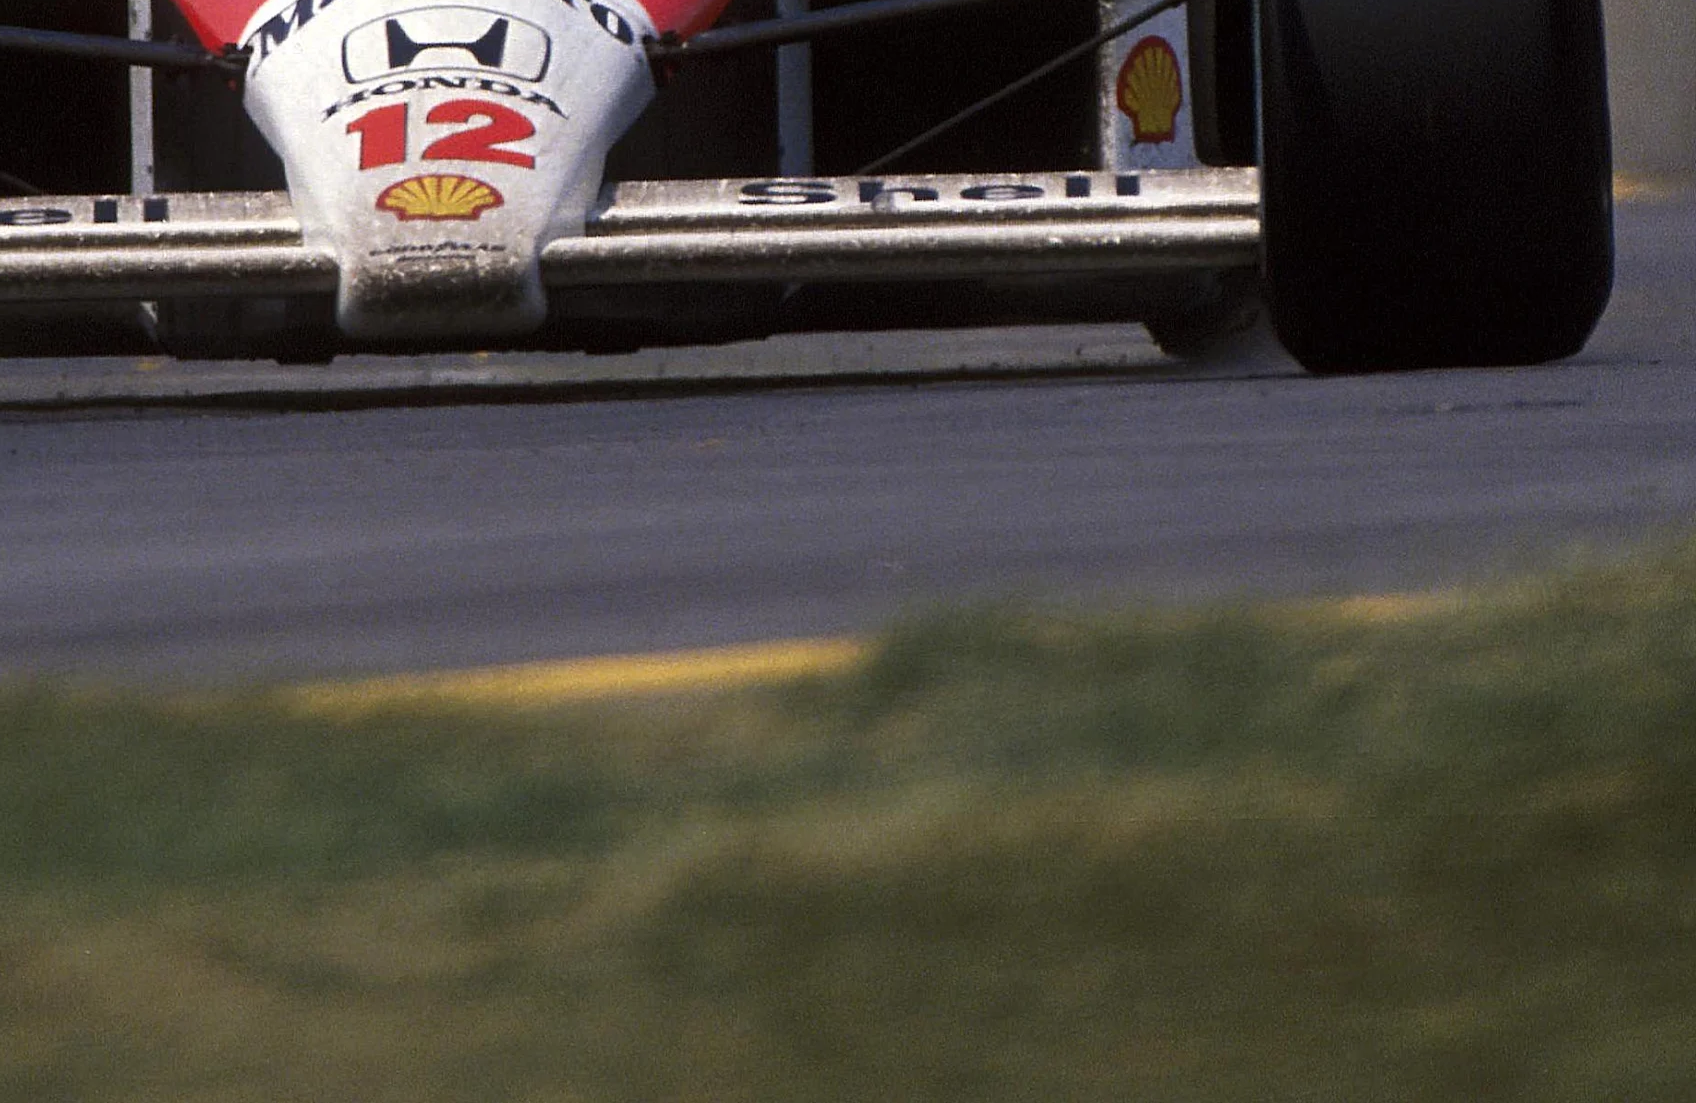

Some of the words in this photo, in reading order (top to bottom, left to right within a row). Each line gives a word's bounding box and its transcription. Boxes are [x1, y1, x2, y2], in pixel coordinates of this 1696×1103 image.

[322, 75, 569, 124] HONDA
[347, 99, 537, 171] 12
[738, 174, 1141, 205] Shell
